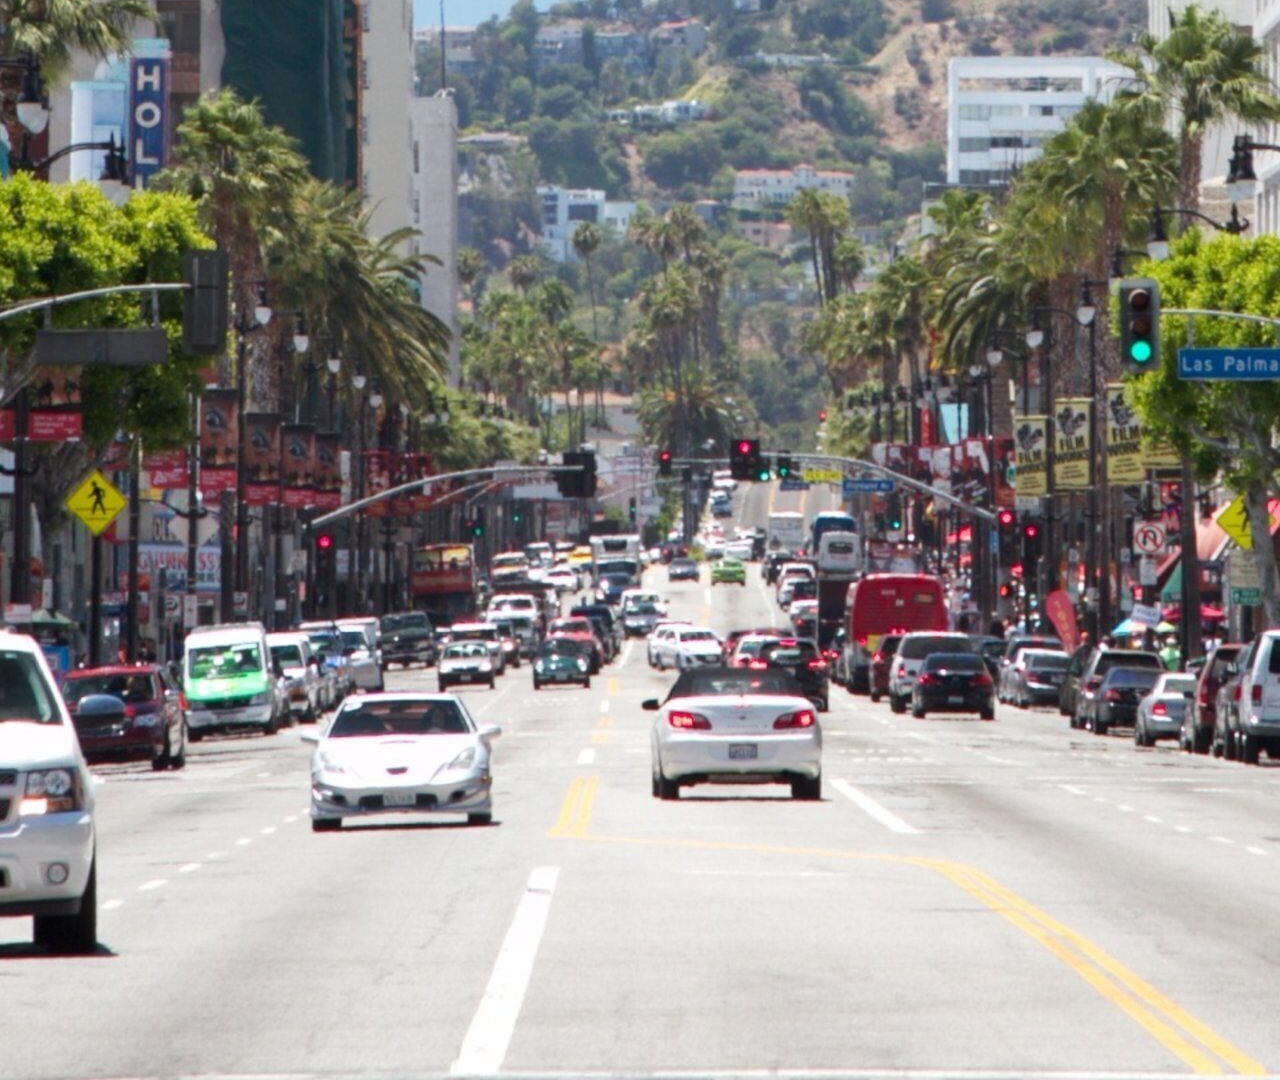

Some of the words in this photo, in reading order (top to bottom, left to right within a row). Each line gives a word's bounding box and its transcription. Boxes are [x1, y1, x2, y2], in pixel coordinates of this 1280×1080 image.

[1181, 355, 1213, 372] Las
[1059, 436, 1085, 452] FILM
[138, 551, 216, 568] GUINNSS
